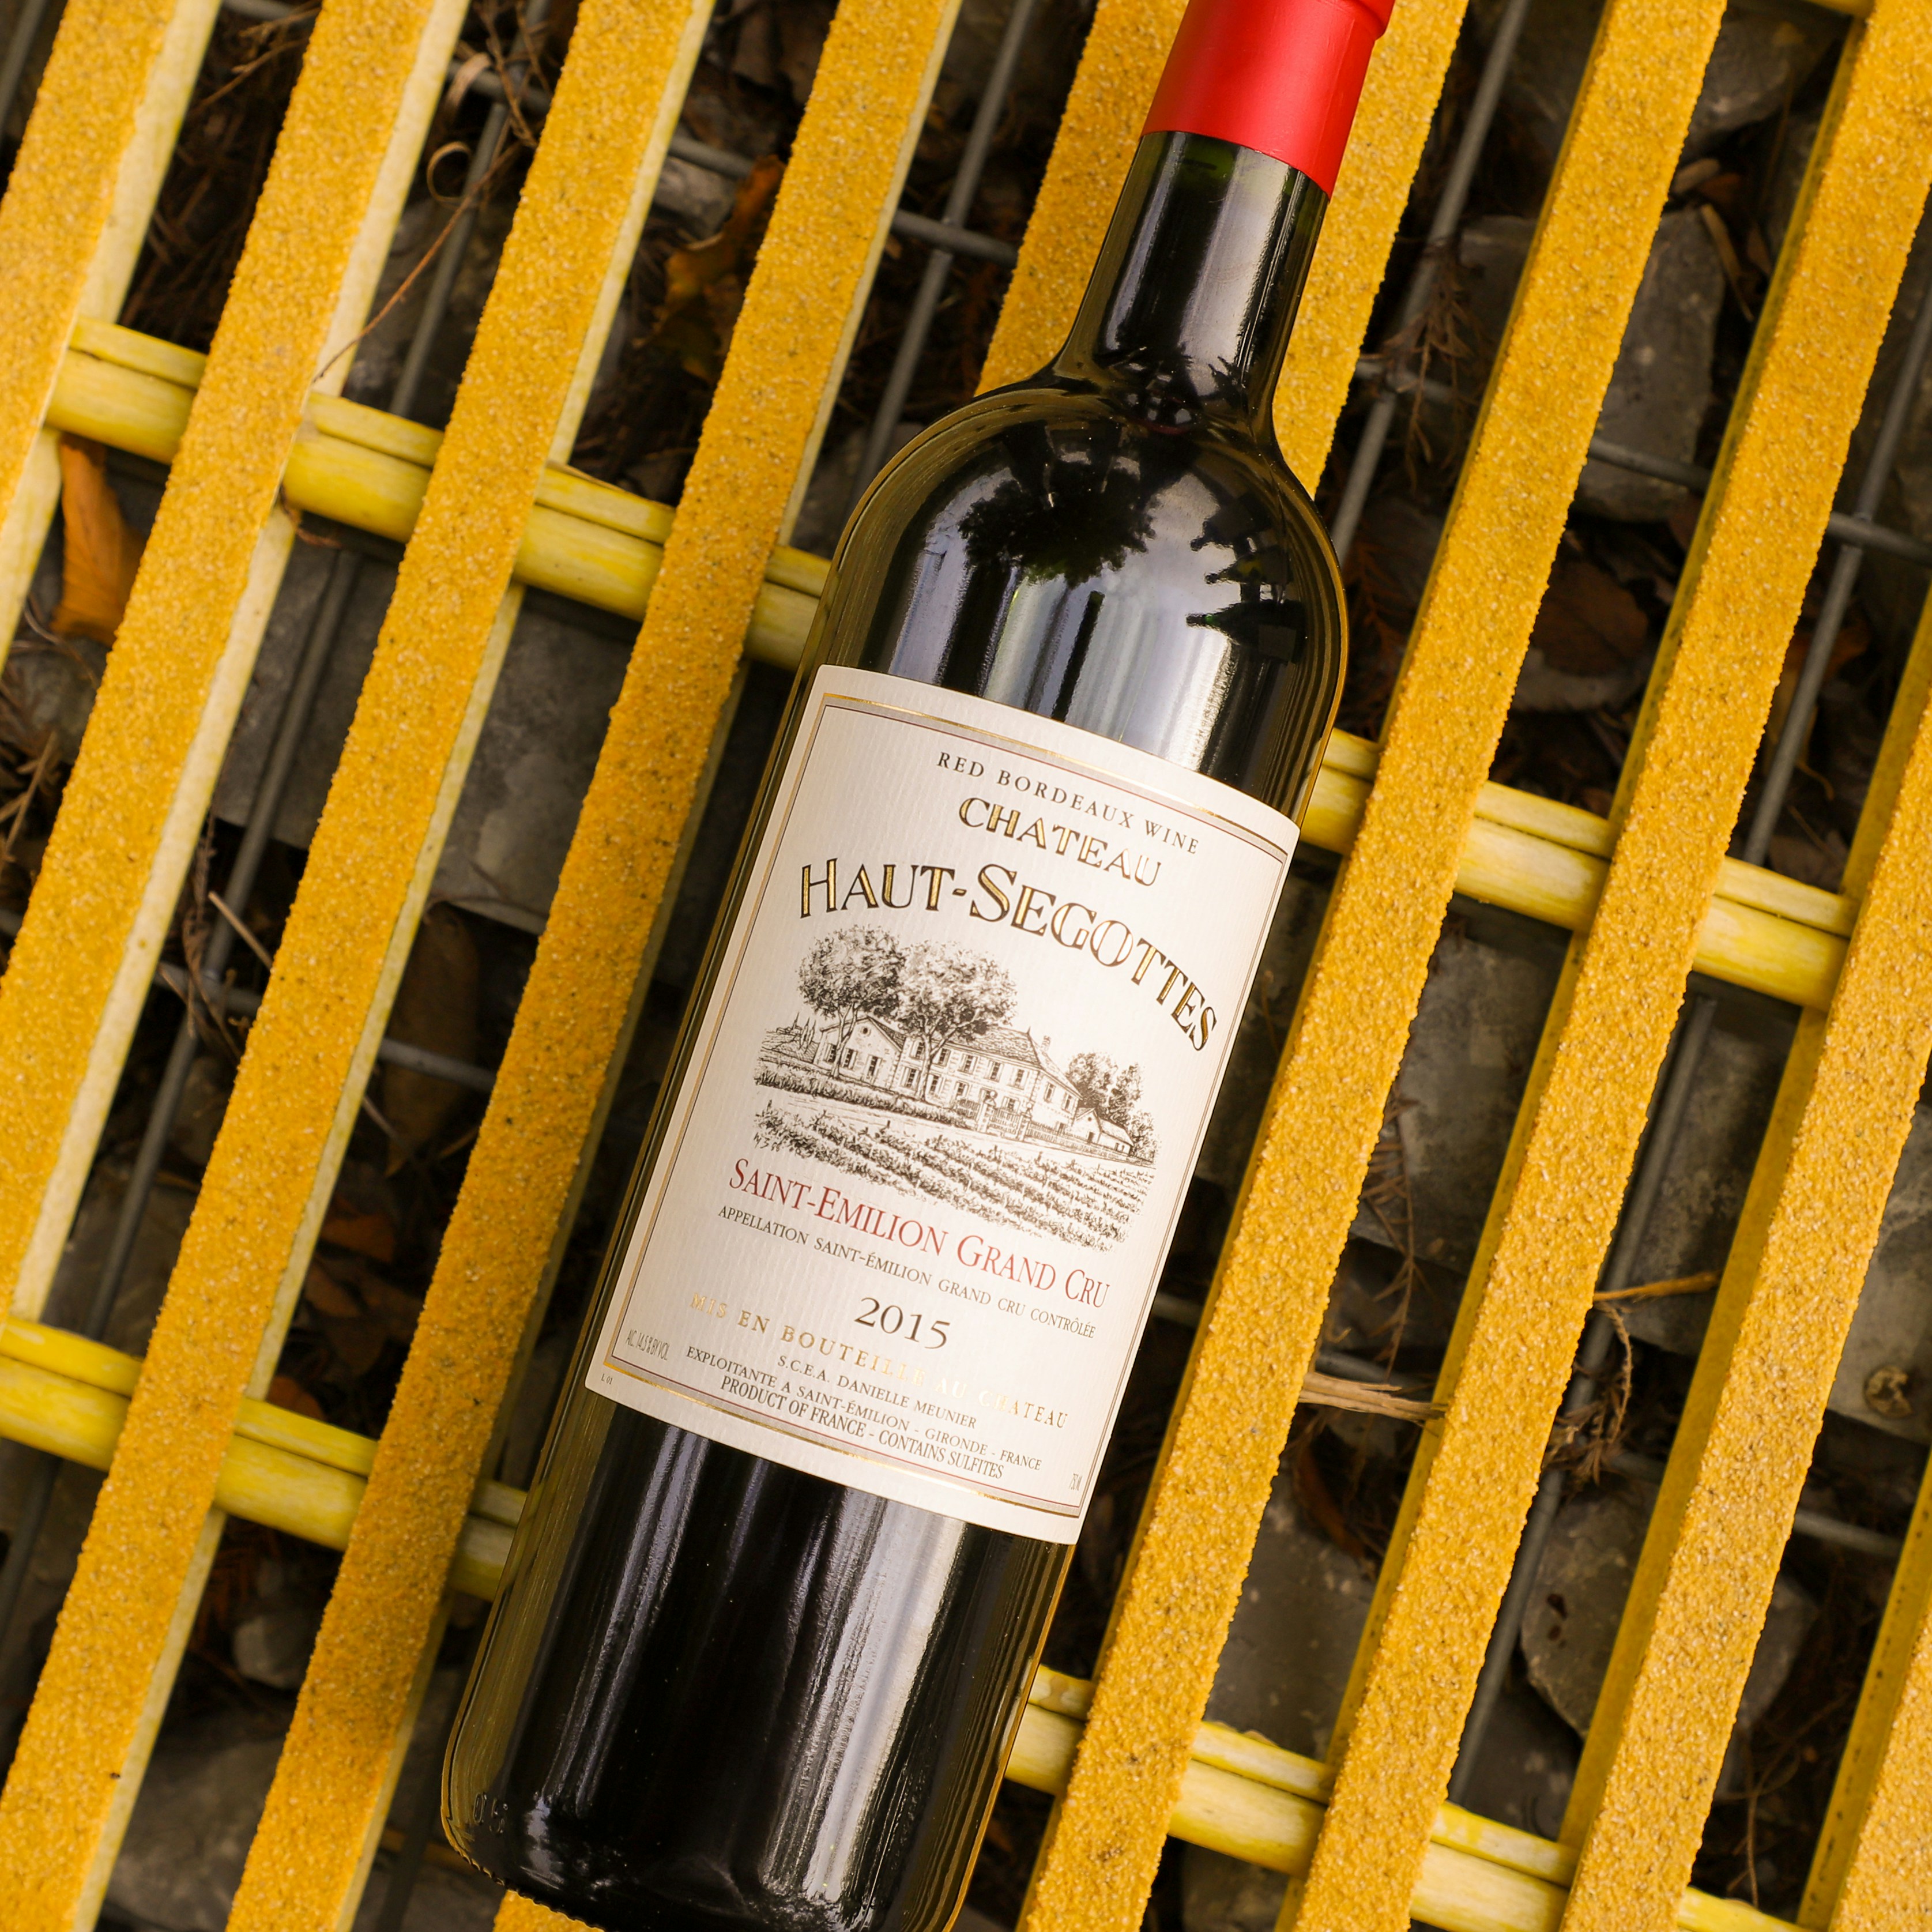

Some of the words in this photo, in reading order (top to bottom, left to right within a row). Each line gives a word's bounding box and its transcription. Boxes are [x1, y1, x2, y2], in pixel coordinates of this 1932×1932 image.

[937, 752, 984, 777] RED
[996, 770, 1135, 829] BORDEAUX
[1144, 820, 1199, 854] WINE
[958, 797, 1161, 886] CHATEAU
[800, 858, 1217, 1050] HAUT-SEGOTTES
[718, 1206, 809, 1245] APPELLATION
[814, 1237, 932, 1285] SAINT-ÉMILION
[938, 1279, 991, 1305] GRAND
[998, 1298, 1026, 1316] CRU
[1031, 1308, 1097, 1338] CONTRÔLÉE
[729, 1158, 948, 1256] SAINT-EMILION
[958, 1235, 1056, 1290] GRAND
[1065, 1269, 1110, 1308] CRU
[690, 1293, 727, 1319] MIS
[737, 1310, 770, 1334] EN
[781, 1325, 925, 1387] BOUTEILLE
[936, 1377, 967, 1399] AU
[978, 1390, 1068, 1428] CHATEAU
[854, 1297, 951, 1349] 2015
[687, 1346, 777, 1388] EXPLOITANTE
[781, 1381, 792, 1393] A
[797, 1385, 910, 1432] SAINT-ÉMILION
[925, 1428, 988, 1456] GIRONDE
[1000, 1450, 1042, 1470] FRANCE
[721, 1376, 787, 1410] PRODUCT
[789, 1400, 808, 1417] OF
[809, 1407, 867, 1437] FRANCE
[879, 1430, 946, 1462] CONTAINS
[948, 1451, 1004, 1479] SULFITES
[837, 1375, 909, 1408] DANIELLE
[914, 1400, 977, 1429] MEUNIER
